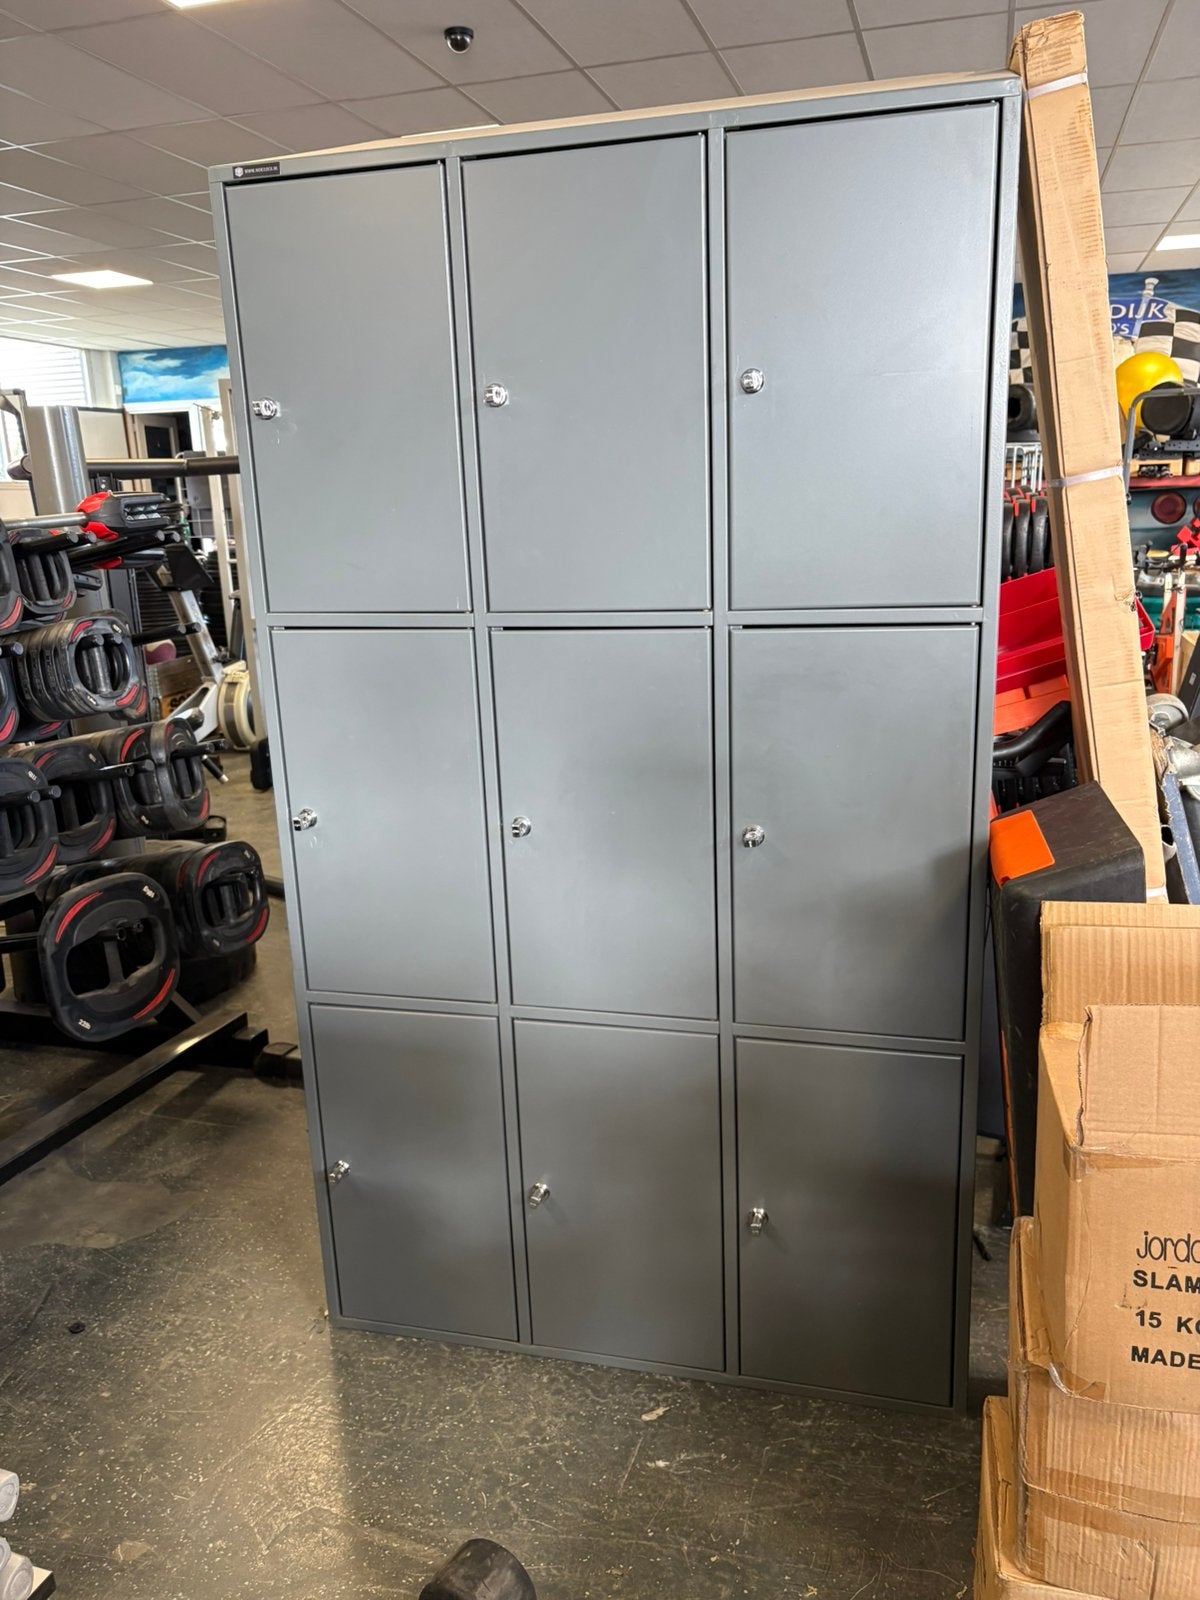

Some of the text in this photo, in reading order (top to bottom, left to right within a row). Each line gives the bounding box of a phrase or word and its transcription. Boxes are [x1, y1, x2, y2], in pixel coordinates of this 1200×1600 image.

[1133, 1269, 1200, 1295] SLAM
[1135, 1309, 1162, 1329] 15
[1131, 1345, 1200, 1370] MADE
